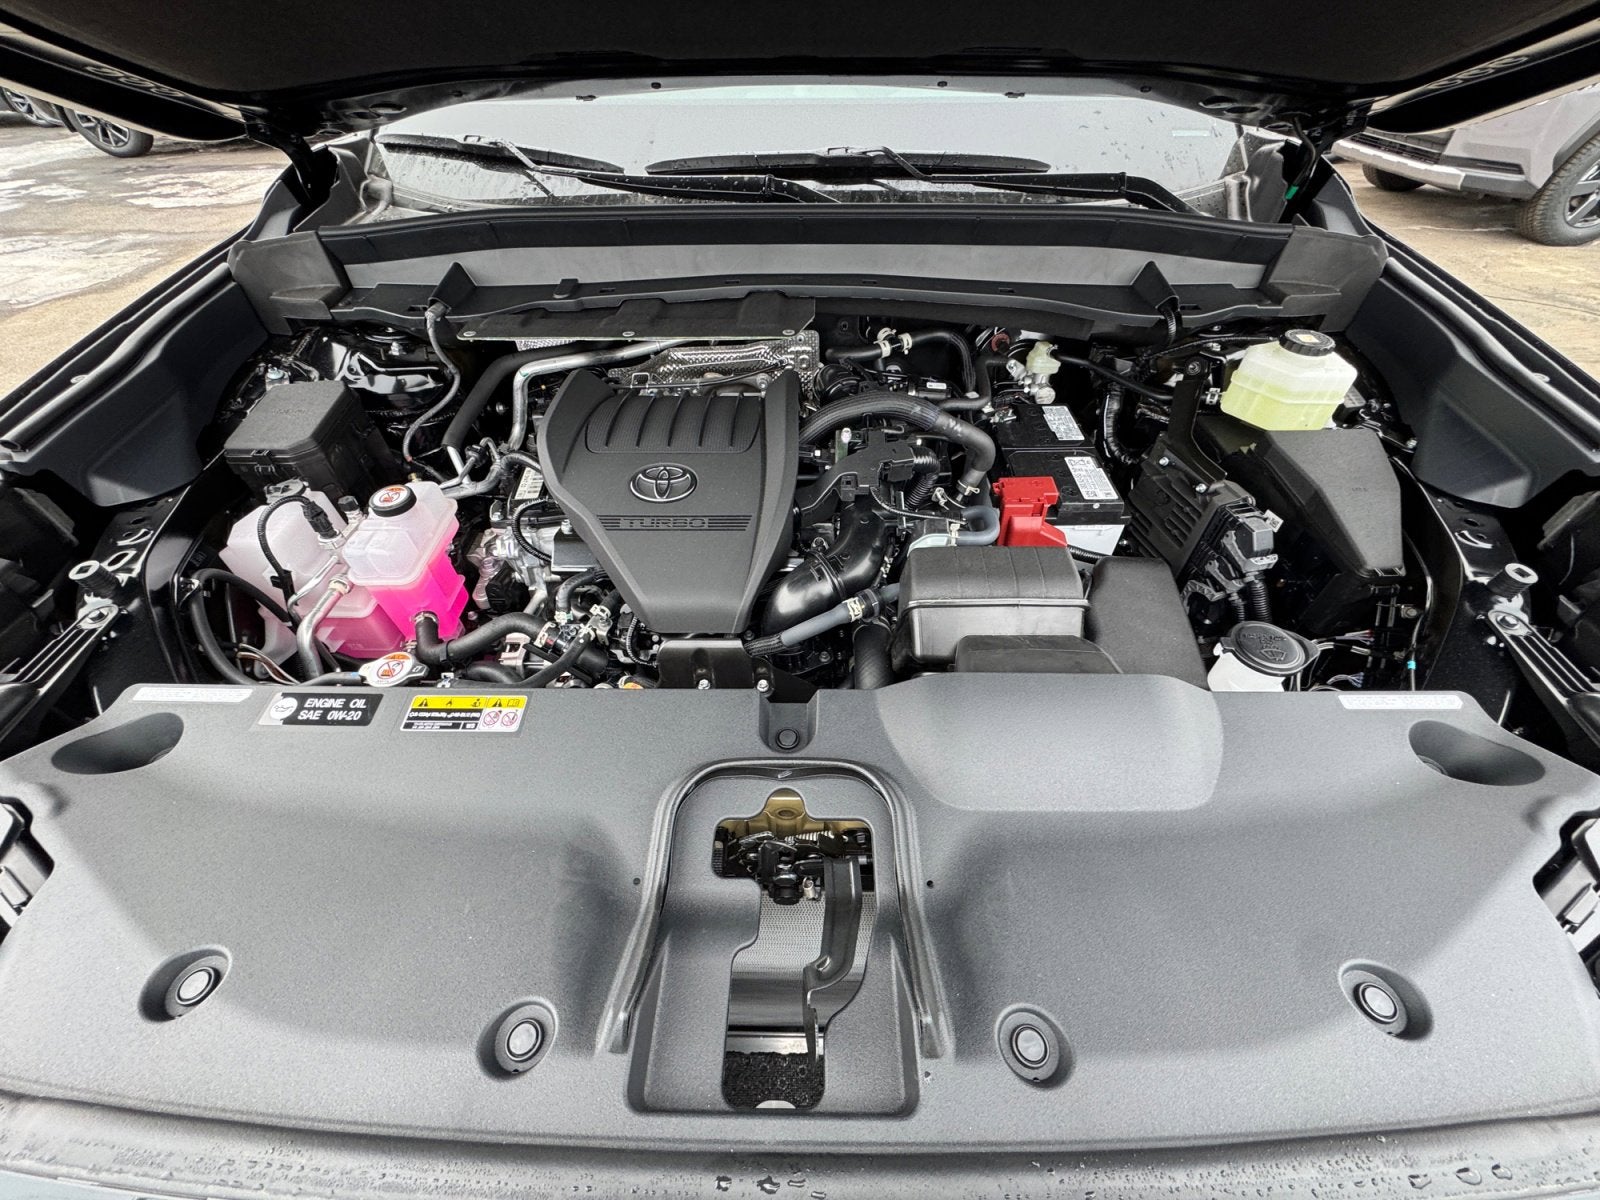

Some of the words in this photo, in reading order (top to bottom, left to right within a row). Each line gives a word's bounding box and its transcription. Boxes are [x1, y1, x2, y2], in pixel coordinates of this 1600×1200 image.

[623, 518, 706, 528] TURBO
[303, 698, 346, 708] ENGINE
[349, 698, 367, 708] OIL
[297, 710, 323, 720] SAE
[327, 710, 362, 720] 0W-20
